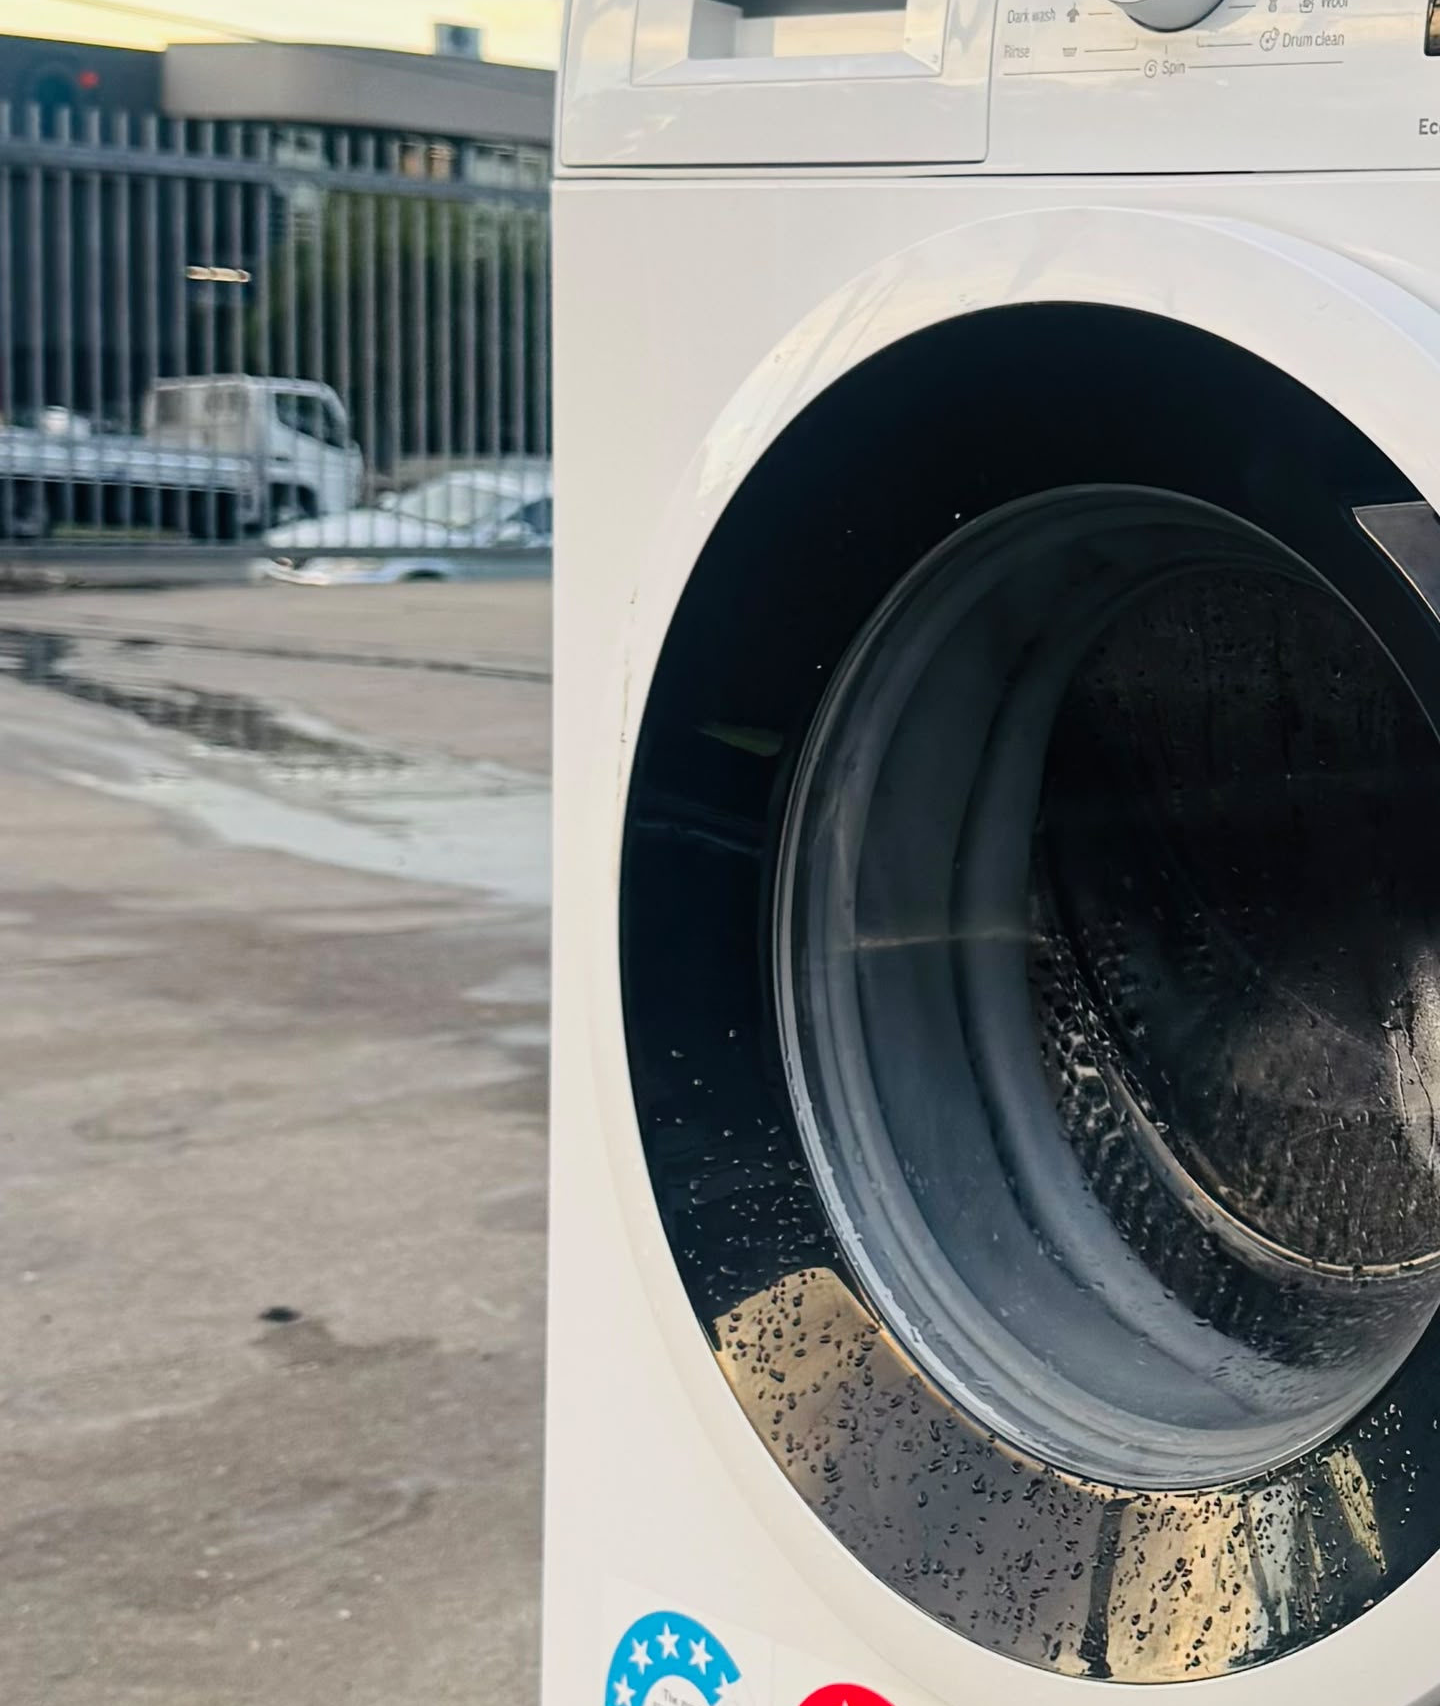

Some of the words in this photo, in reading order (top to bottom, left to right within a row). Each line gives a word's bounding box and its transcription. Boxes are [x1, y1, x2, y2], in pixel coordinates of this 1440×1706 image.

[1007, 8, 1030, 24] Dark
[1031, 7, 1056, 22] wash
[1282, 32, 1312, 48] Drum
[1314, 31, 1345, 46] clean
[1004, 44, 1031, 59] Rinse
[1162, 59, 1186, 77] Spin
